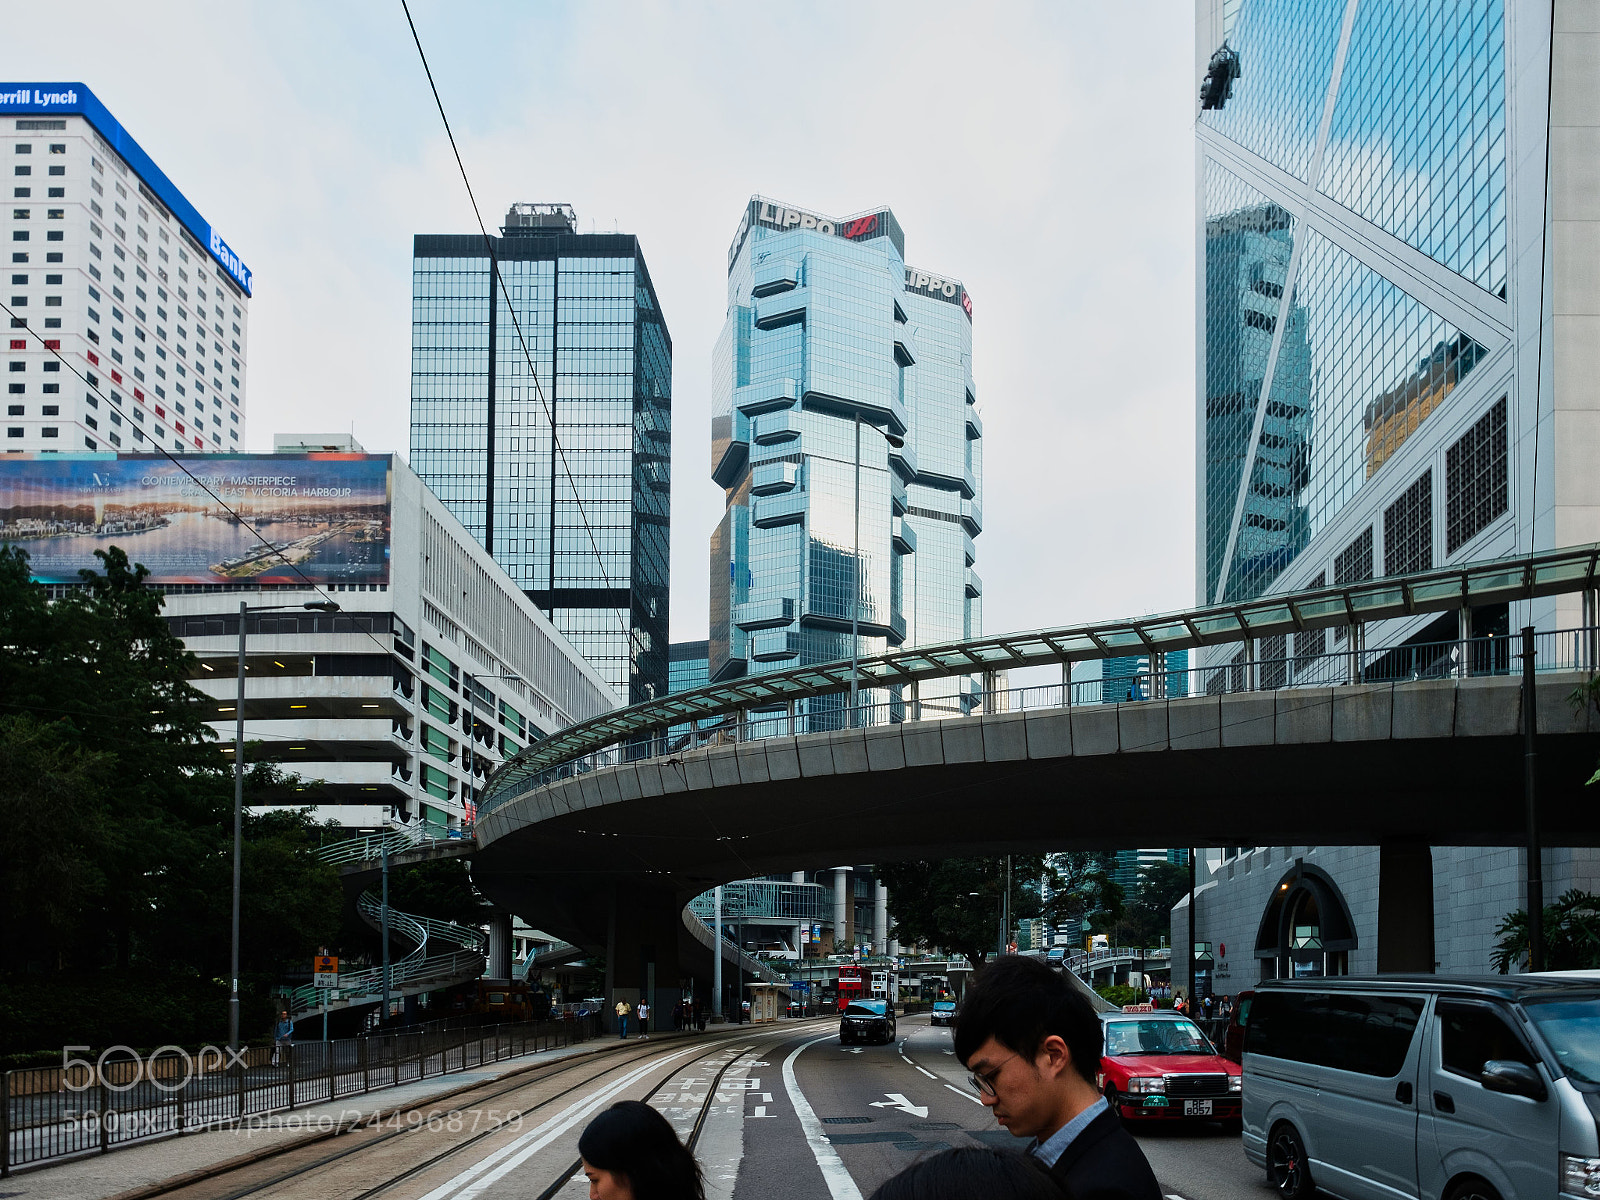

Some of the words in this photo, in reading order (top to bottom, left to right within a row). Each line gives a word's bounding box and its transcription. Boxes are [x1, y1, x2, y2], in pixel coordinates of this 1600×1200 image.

[34, 90, 77, 106] Lynch
[760, 202, 835, 236] LIPPO
[210, 227, 247, 286] Bank
[904, 270, 957, 298] IPPO
[142, 476, 226, 486] CONTEMPORARY
[230, 476, 297, 486] MASTERPIECE
[224, 488, 247, 497] EAST
[251, 488, 298, 497] VICTORIA
[303, 488, 352, 497] HARBOUR
[1125, 1005, 1152, 1013] TAXI
